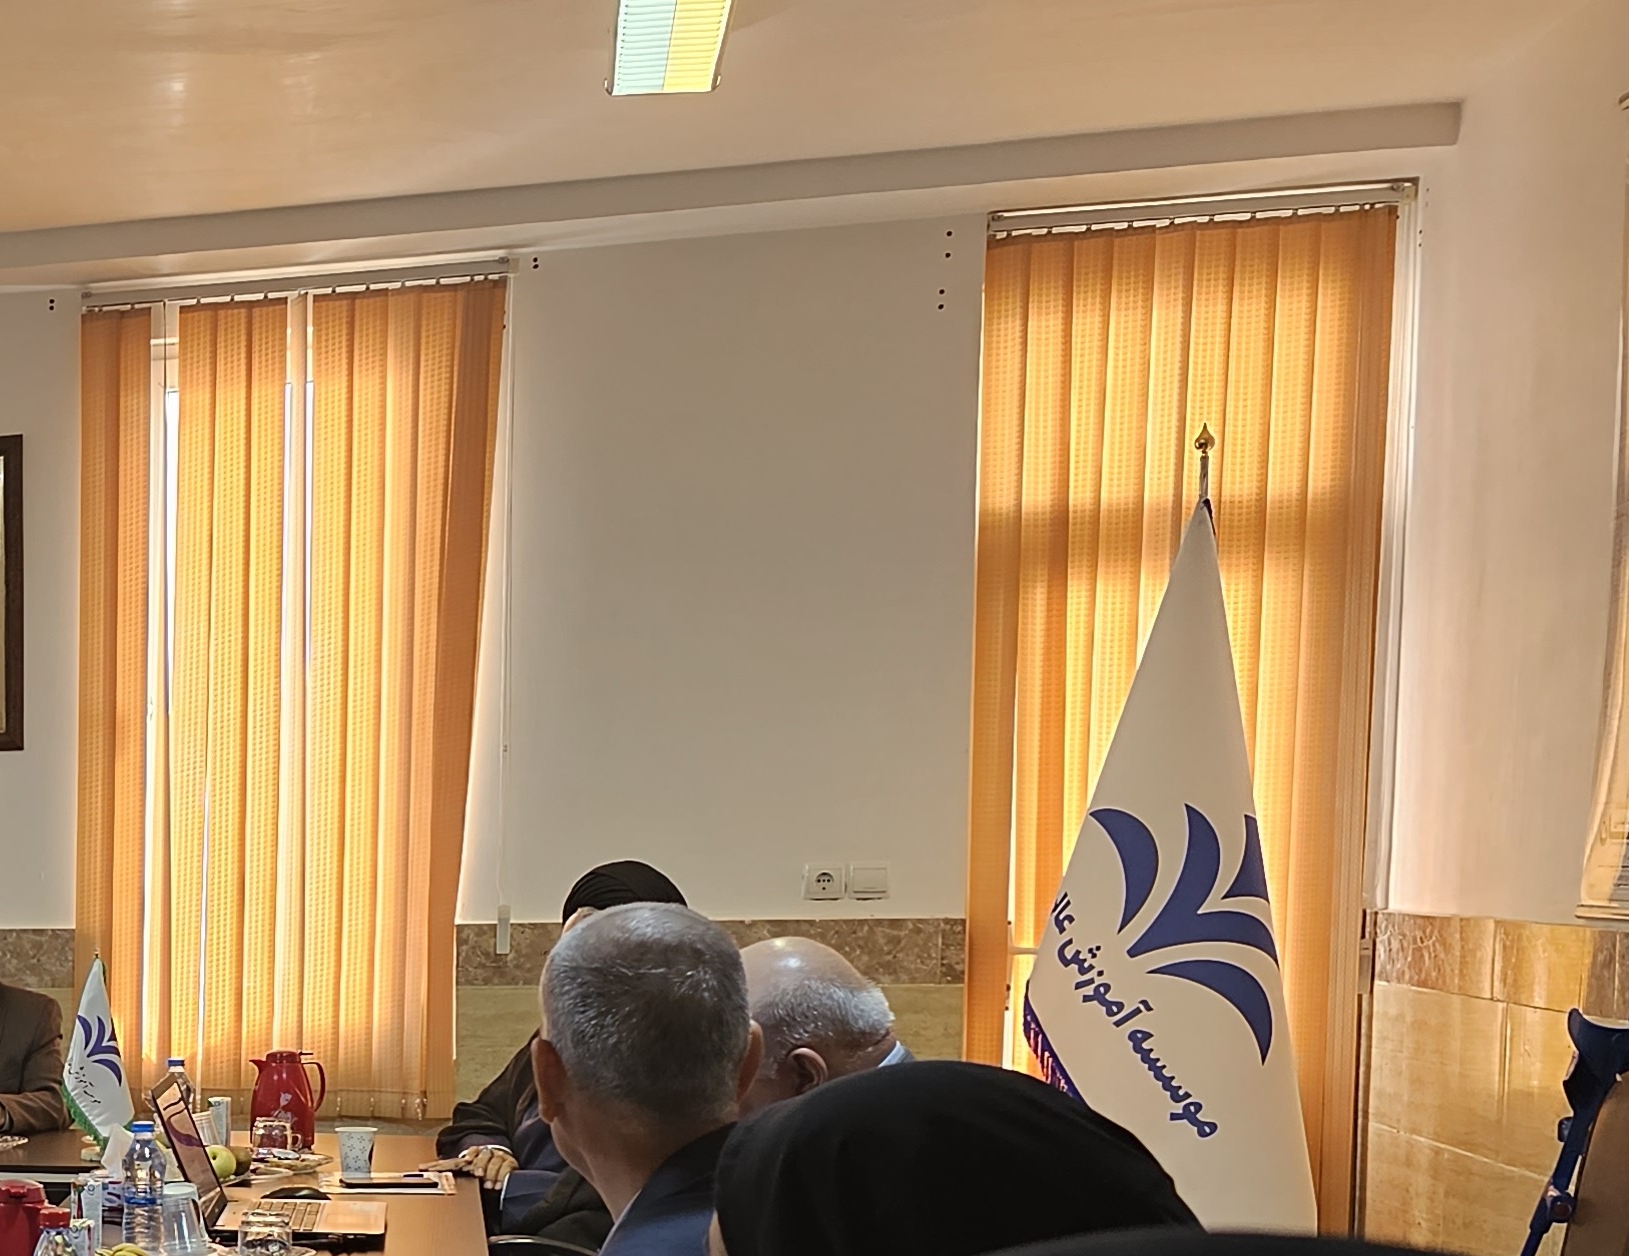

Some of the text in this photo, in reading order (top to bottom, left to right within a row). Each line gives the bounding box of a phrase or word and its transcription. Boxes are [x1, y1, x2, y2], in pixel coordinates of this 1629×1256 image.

[1051, 891, 1218, 1138] موسسه آموزش عال
